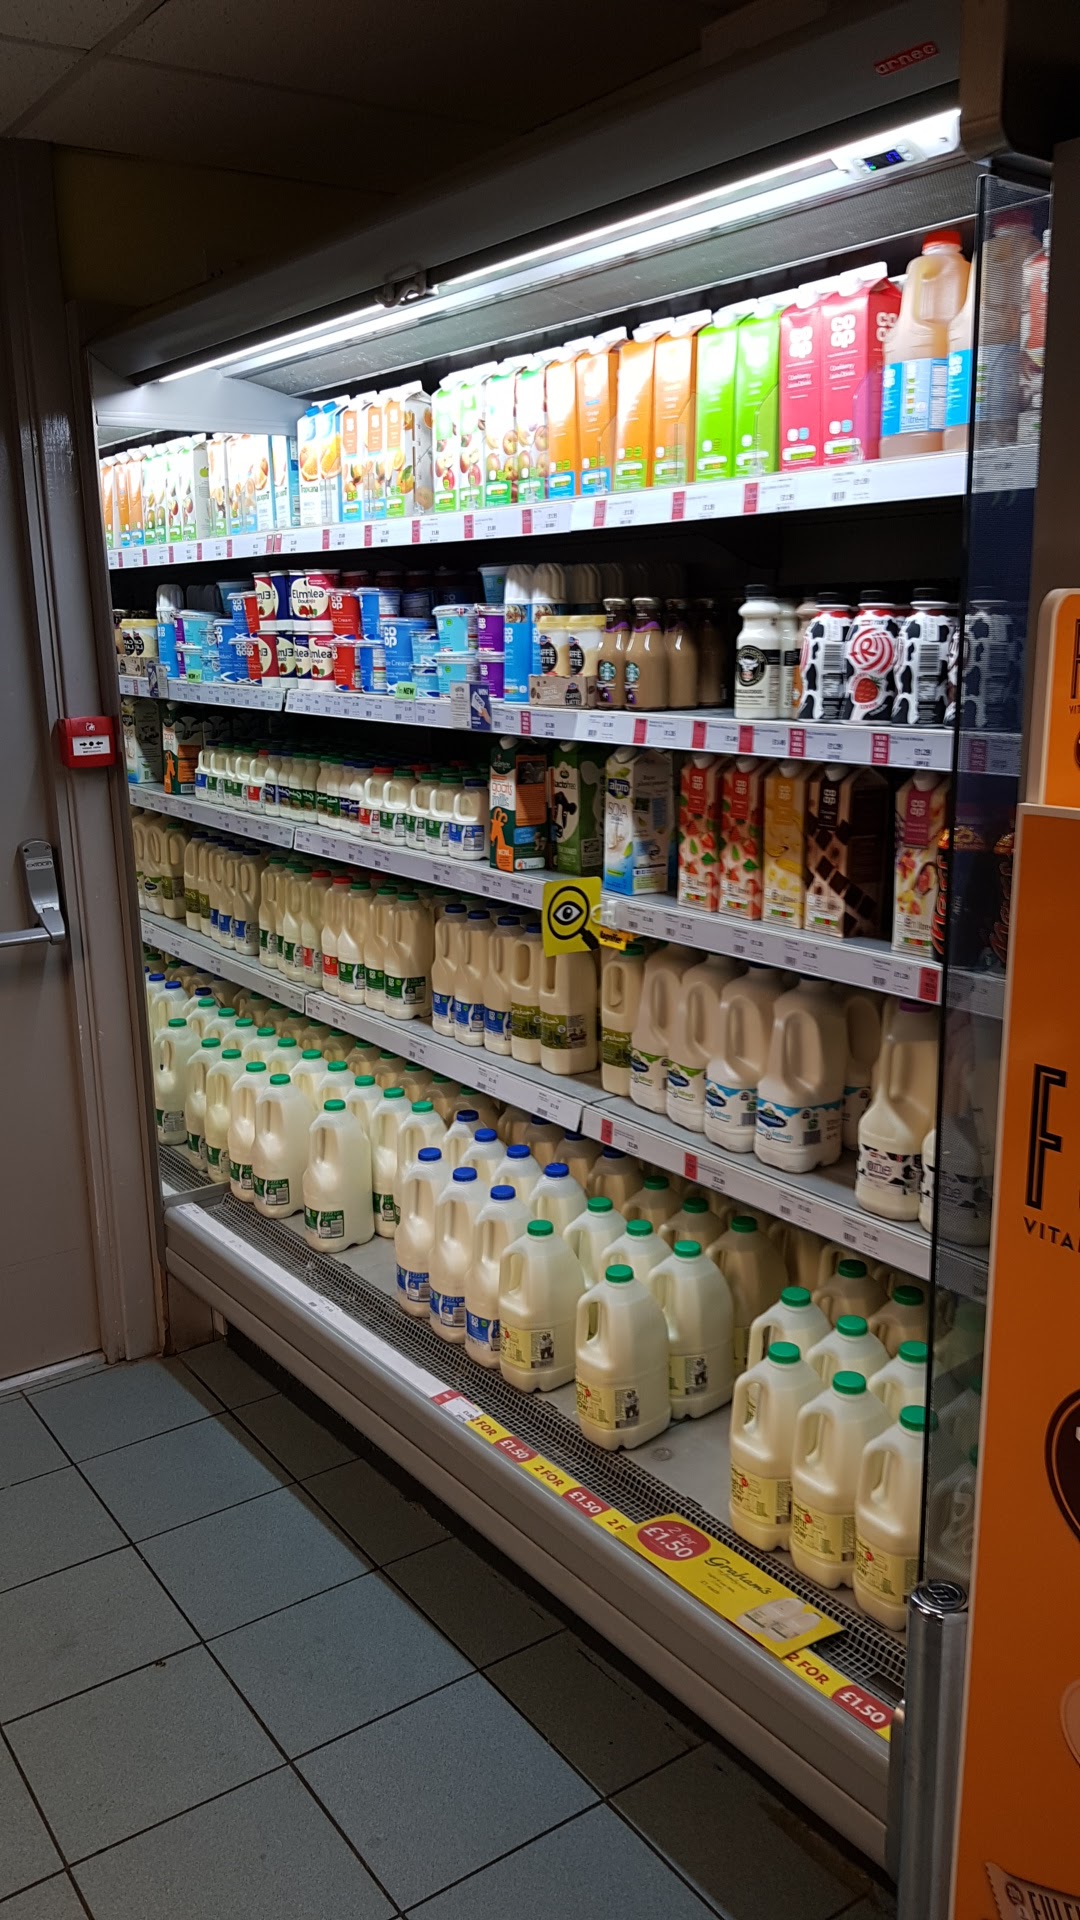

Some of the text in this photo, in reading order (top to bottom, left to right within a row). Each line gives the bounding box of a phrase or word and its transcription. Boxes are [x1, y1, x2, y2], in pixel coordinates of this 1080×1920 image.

[385, 627, 397, 637] co
[385, 637, 397, 648] op
[403, 687, 415, 695] NEW
[609, 780, 629, 794] alpro
[608, 802, 628, 817] SOYA
[475, 1420, 497, 1436] FOR
[500, 1439, 530, 1460] £1.50
[533, 1465, 544, 1474] 2
[541, 1469, 564, 1487] FOR
[569, 1491, 602, 1515] £1.50
[607, 1518, 617, 1528] 2
[644, 1526, 694, 1559] £1.50
[667, 1526, 698, 1547] 2 for
[704, 1556, 773, 1595] Graham's
[797, 1660, 830, 1686] FOR
[839, 1690, 887, 1725] £1.50
